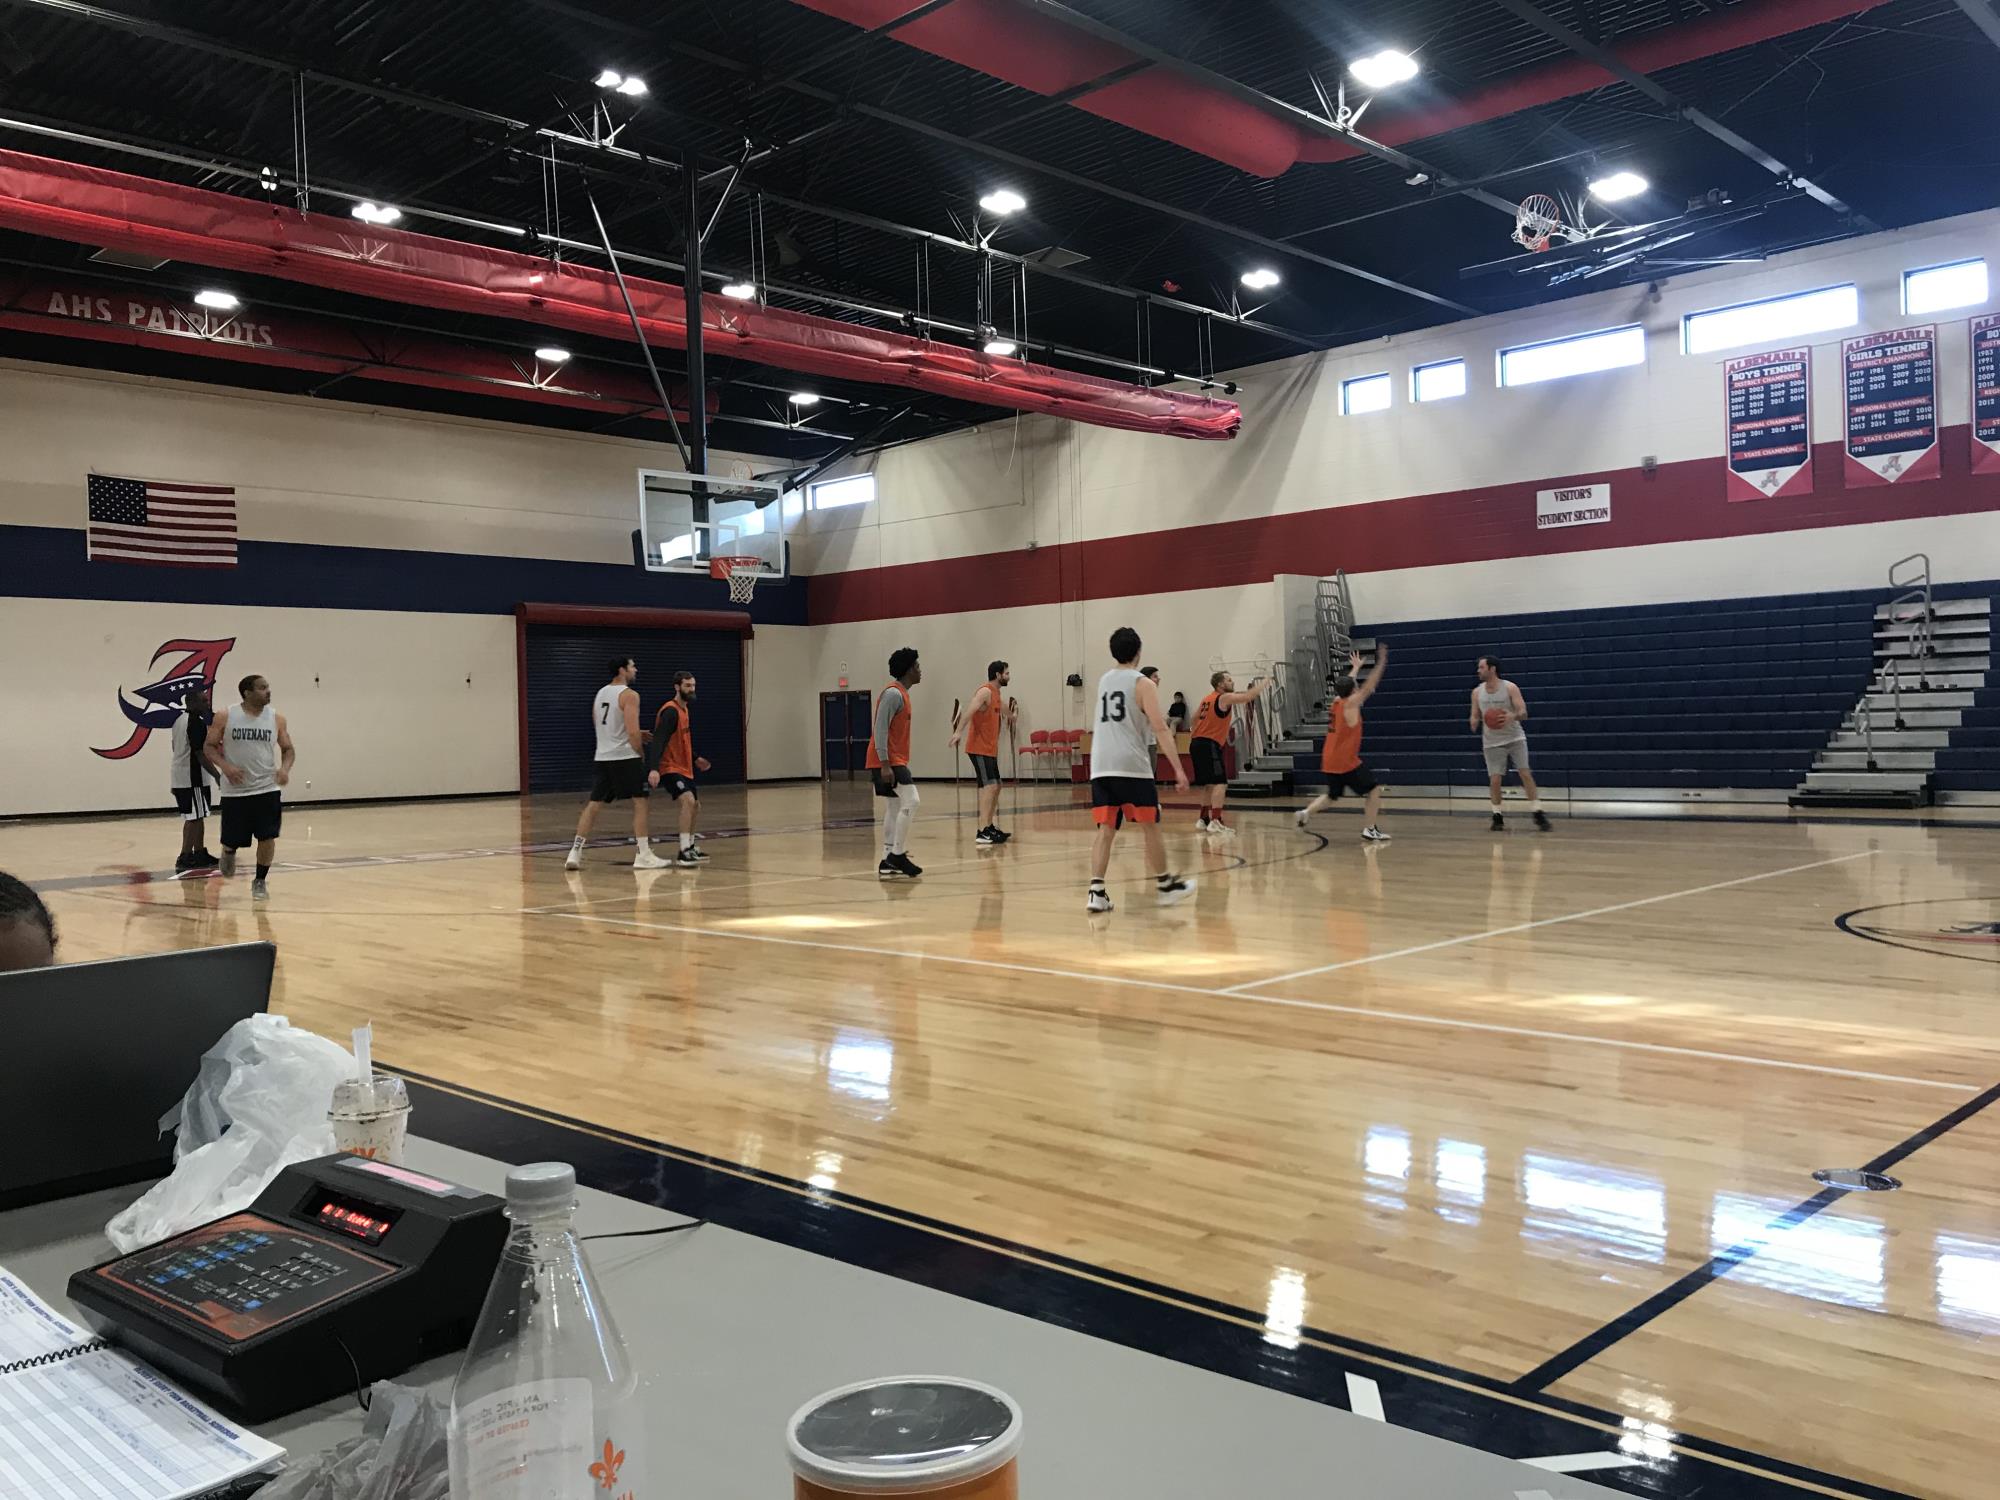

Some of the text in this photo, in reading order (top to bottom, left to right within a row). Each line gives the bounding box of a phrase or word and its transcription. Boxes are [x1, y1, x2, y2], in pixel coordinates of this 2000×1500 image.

[48, 292, 273, 346] AHS PATRIOTS
[1849, 342, 1928, 362] GIRLS TENNIS
[1853, 352, 1924, 368] DISTRICT CHAMPIONS
[1732, 363, 1802, 381] BOYS TENNIS
[1734, 372, 1799, 387] DISTRICT CHAMPIONS
[1856, 398, 1926, 413] REGIONAL CHAMPIONS
[1864, 430, 1923, 442] STATE CHAMPIONS
[1763, 446, 1798, 456] CHAMPIONS
[1554, 488, 1592, 502] VISITOR'S
[1538, 508, 1608, 526] STUDENT SECTION
[601, 702, 610, 725] 7
[1101, 690, 1126, 722] 13
[232, 728, 272, 742] COVENANT
